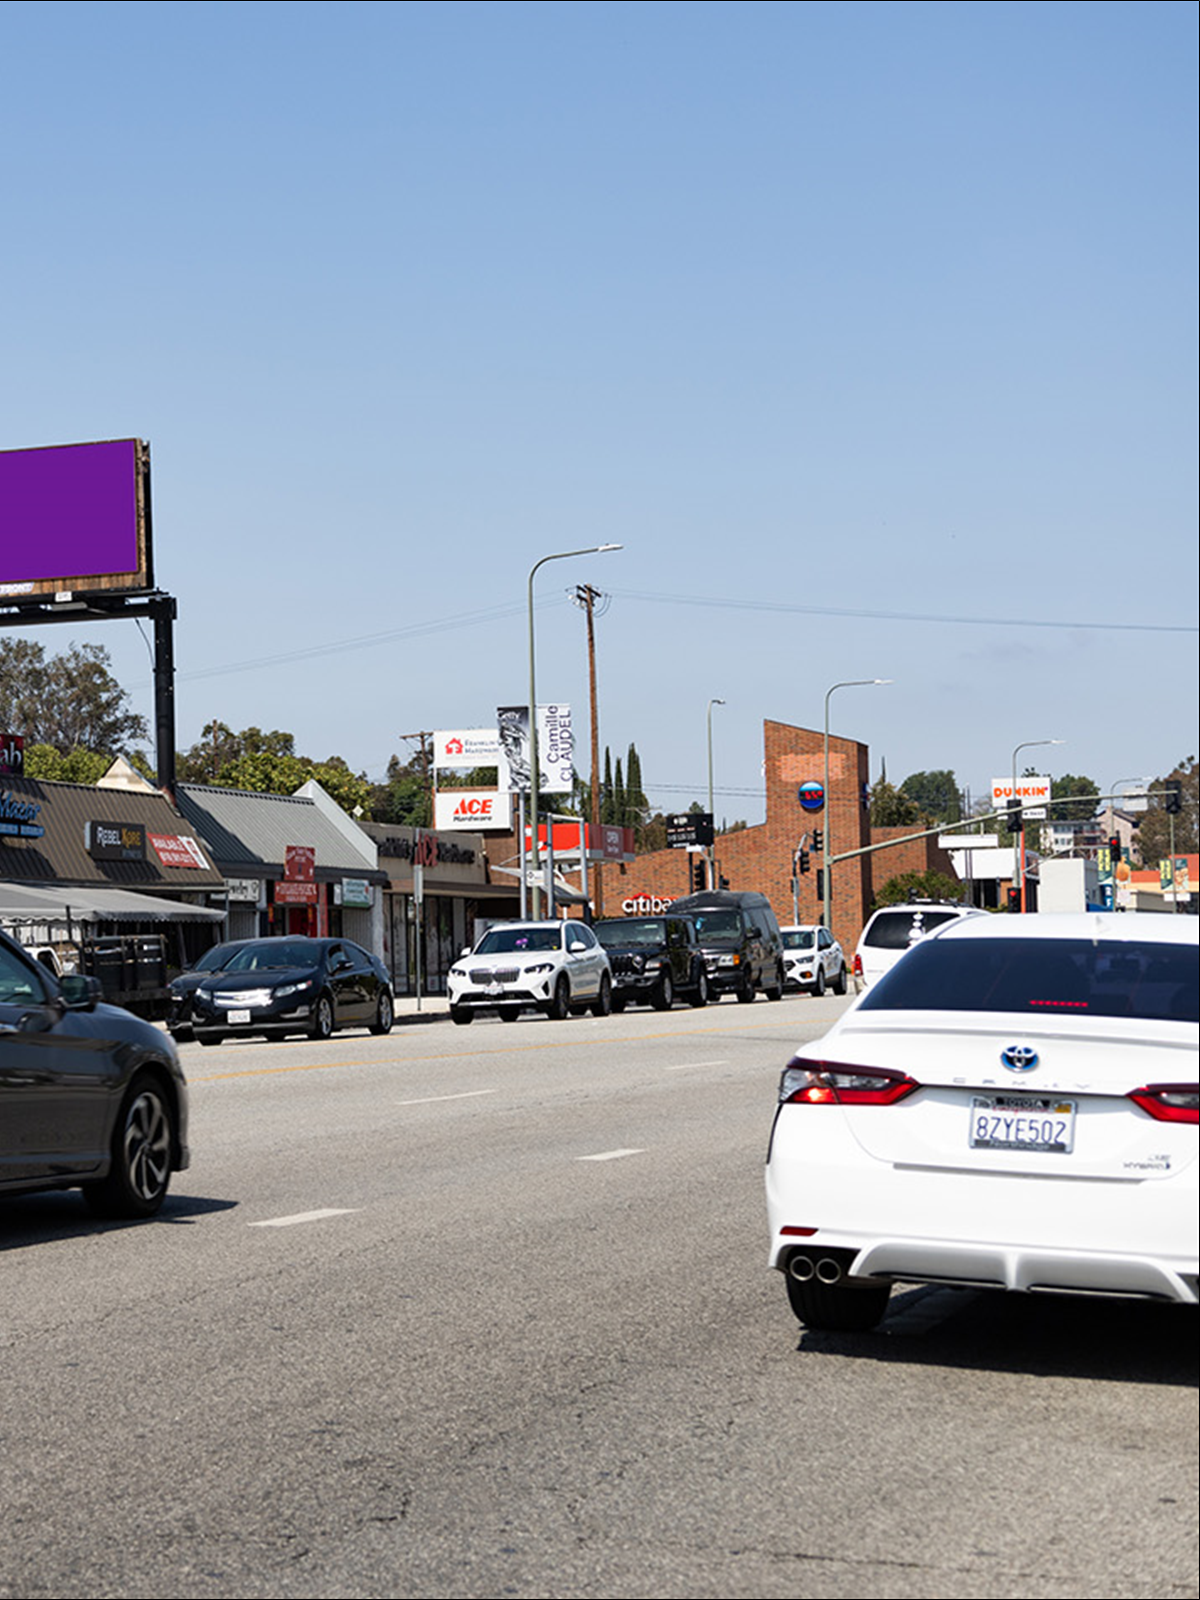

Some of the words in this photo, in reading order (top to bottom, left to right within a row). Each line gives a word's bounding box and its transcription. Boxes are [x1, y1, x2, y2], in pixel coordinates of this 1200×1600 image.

[560, 710, 573, 782] CLAUDEL
[453, 798, 493, 815] ACE
[453, 815, 493, 823] Hardware
[621, 894, 673, 914] citiba
[1002, 1099, 1045, 1108] TOYOTA
[975, 1115, 1067, 1145] 8ZYE502
